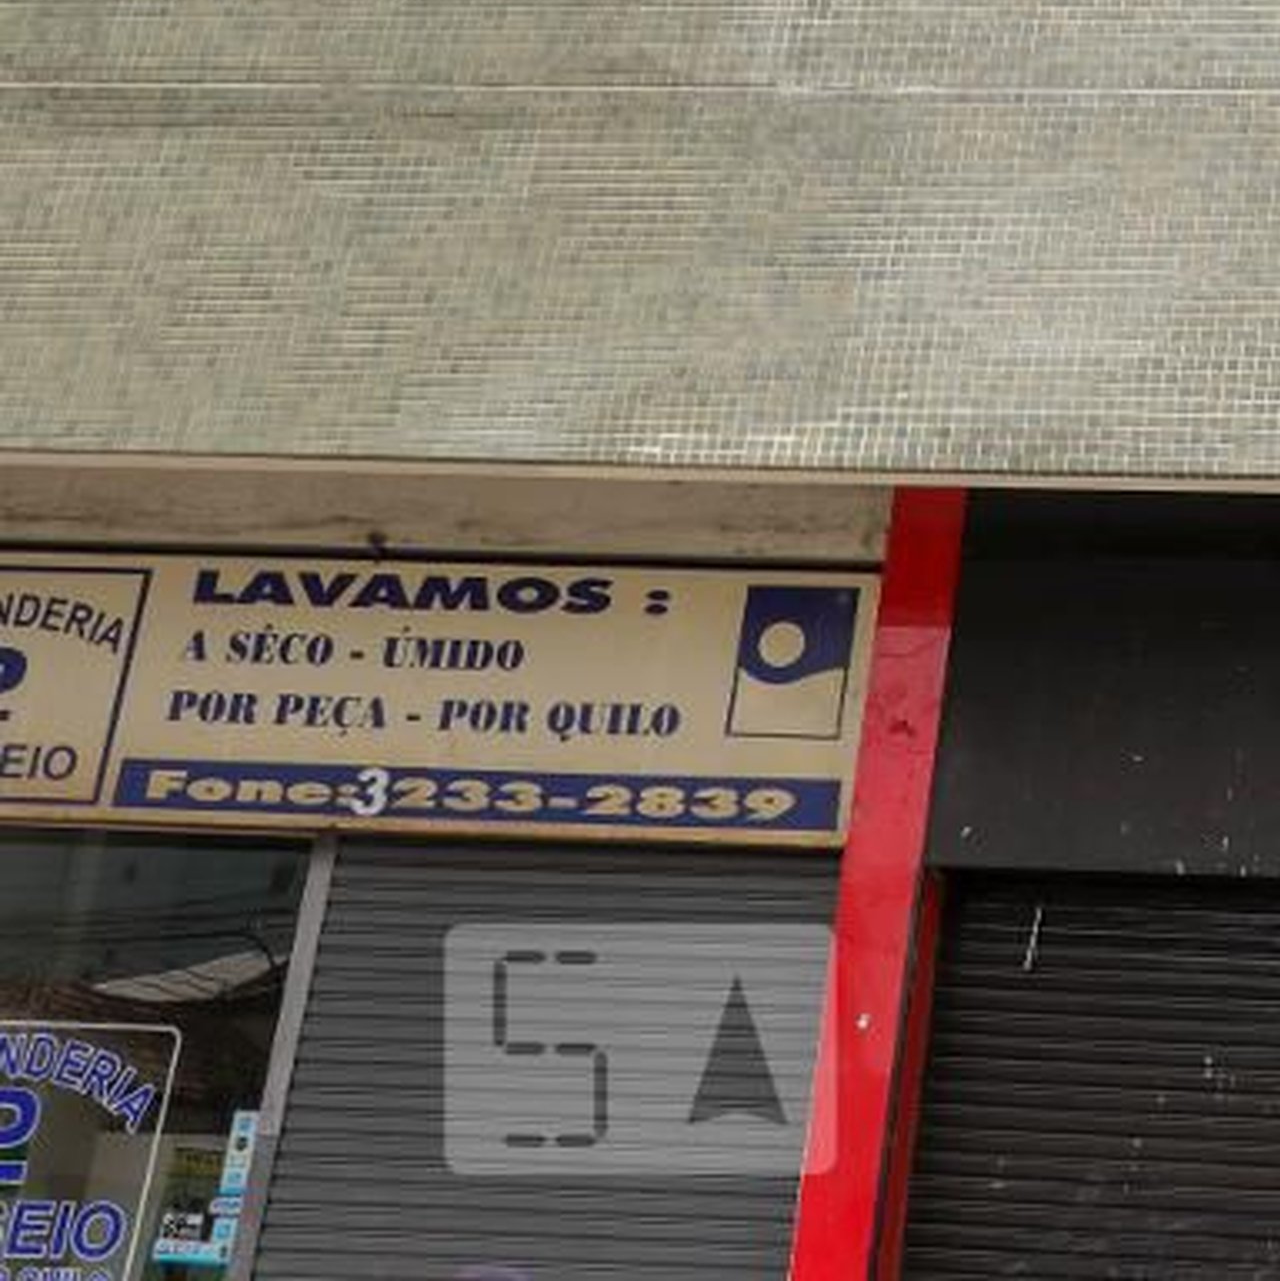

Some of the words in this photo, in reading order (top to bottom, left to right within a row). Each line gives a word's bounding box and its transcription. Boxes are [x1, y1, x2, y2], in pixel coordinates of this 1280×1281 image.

[194, 570, 613, 615] LAVAMOS
[184, 630, 207, 662] A
[166, 690, 258, 725] POR
[273, 694, 386, 736] PEÇA
[437, 699, 530, 733] POR
[547, 702, 681, 743] QUILO
[0, 1200, 126, 1262] EIO
